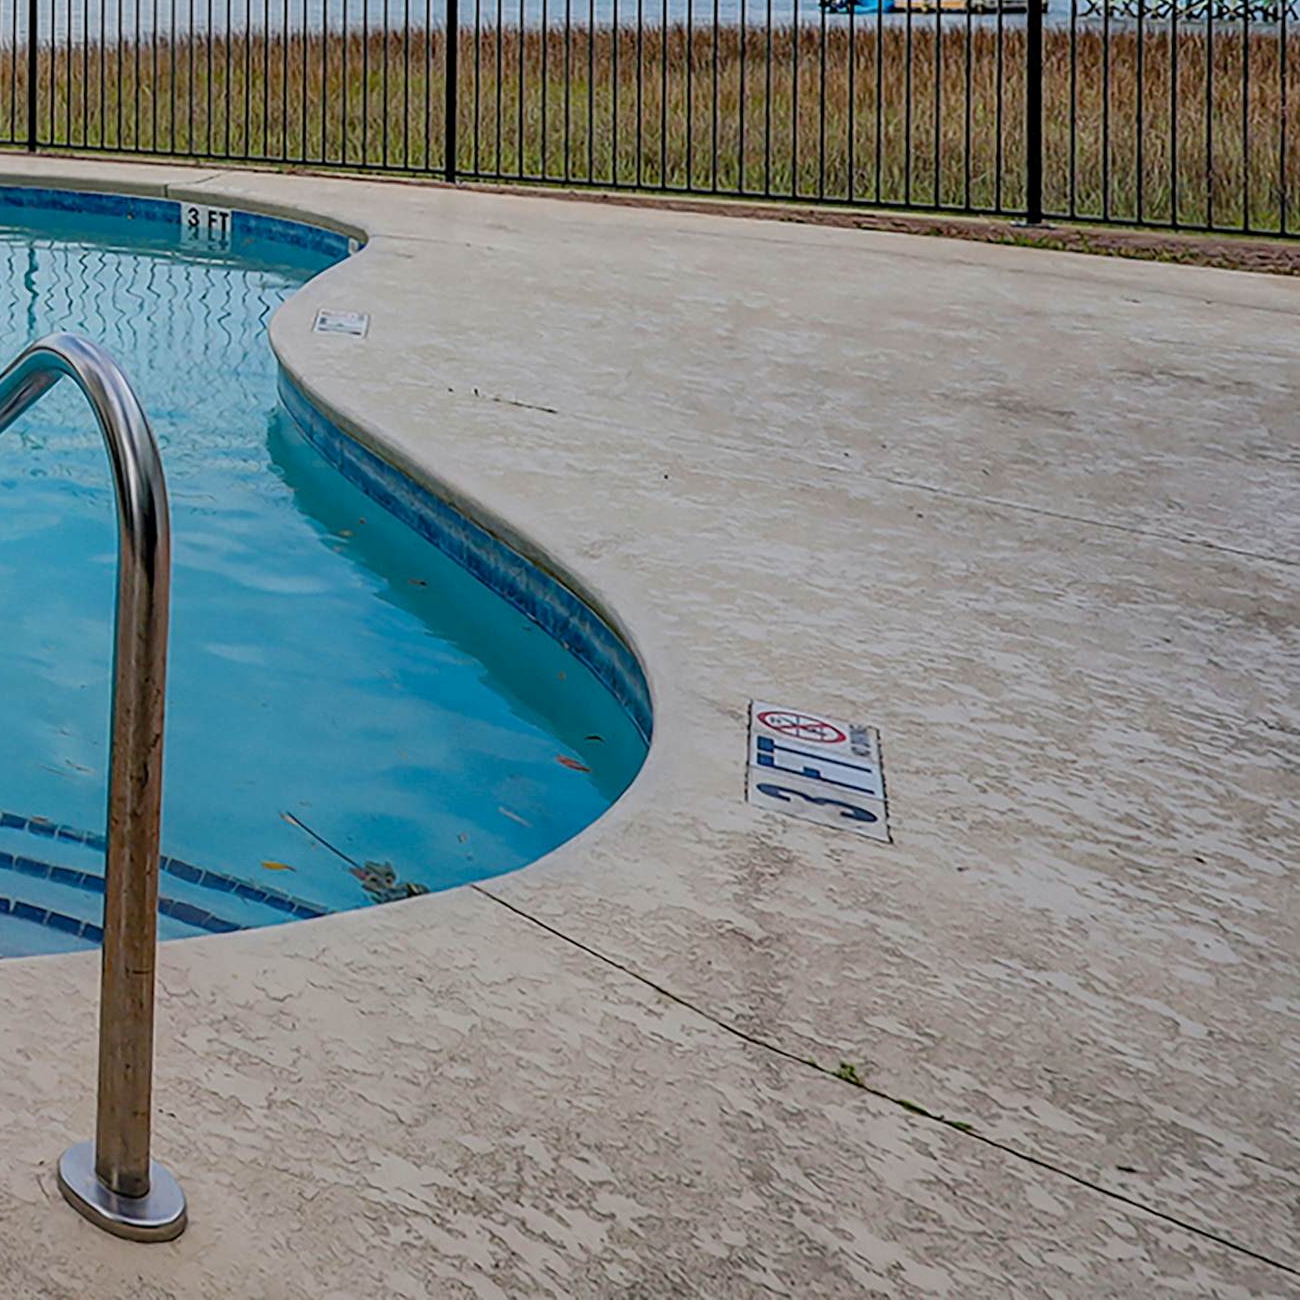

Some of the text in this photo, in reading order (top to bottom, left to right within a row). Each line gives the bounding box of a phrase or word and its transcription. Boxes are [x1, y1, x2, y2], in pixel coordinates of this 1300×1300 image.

[188, 207, 229, 231] 3 FT
[756, 735, 878, 822] 3 FT
